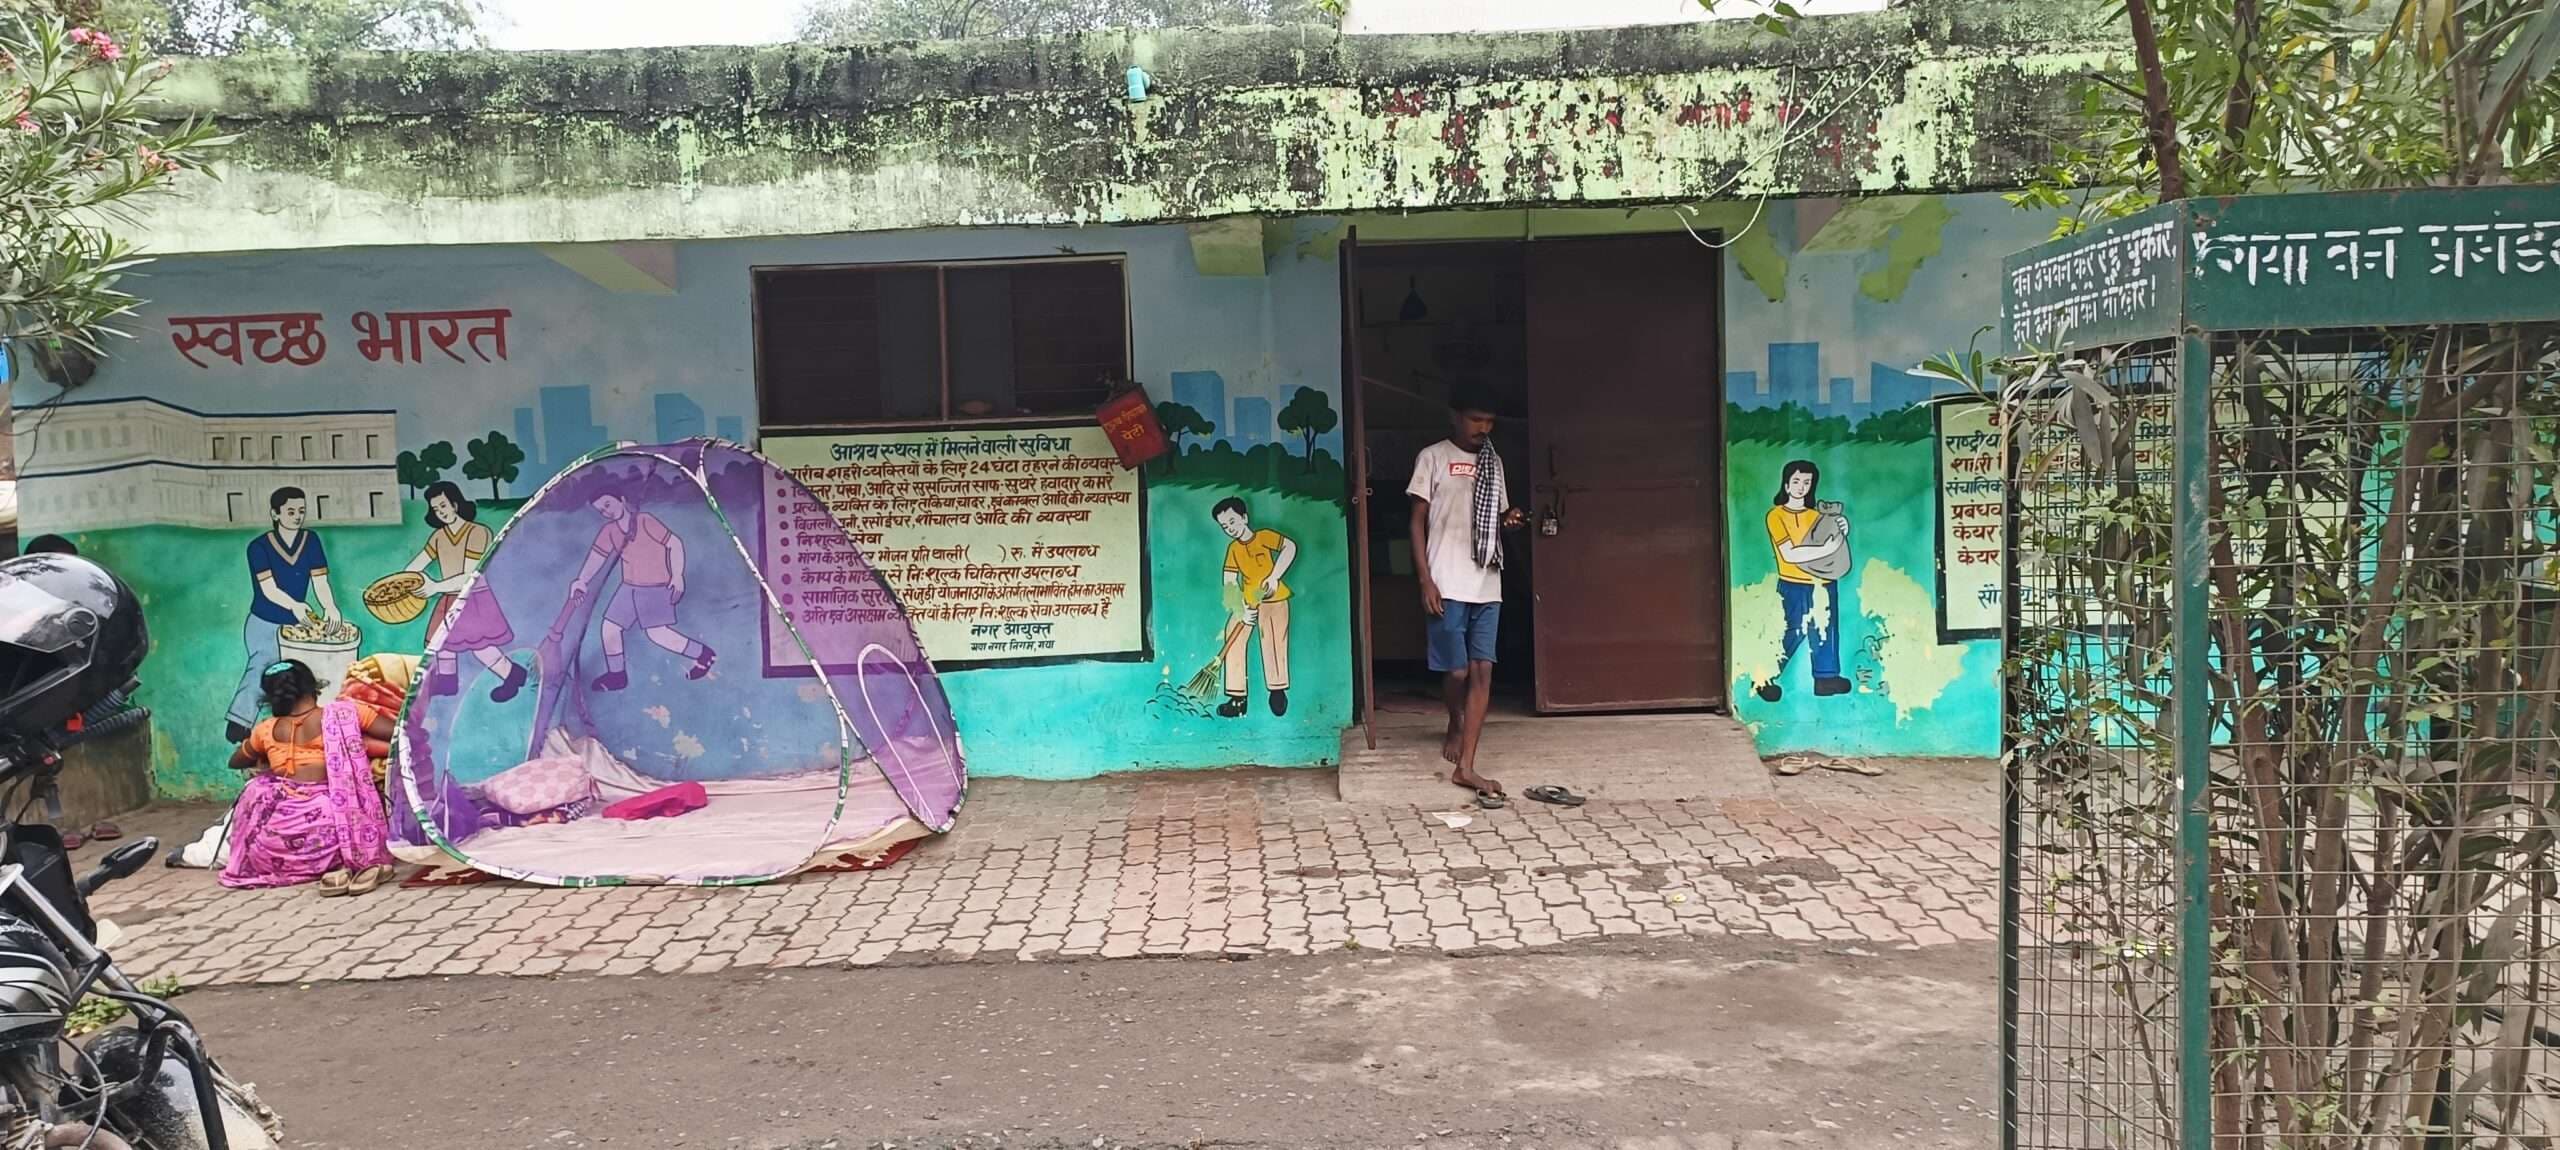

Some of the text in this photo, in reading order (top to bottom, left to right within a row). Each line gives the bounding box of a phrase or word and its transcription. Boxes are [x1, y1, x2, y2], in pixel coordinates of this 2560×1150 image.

[2324, 226, 2404, 280] वन
[2012, 265, 2032, 297] वन
[2073, 243, 2097, 280] कर
[168, 309, 512, 369] स्वच्छ भारत
[831, 433, 1072, 461] आश्रय स्थल में मिलने वाली सुविधा
[826, 462, 862, 481] शहरी
[862, 459, 922, 480] व्यक्तियों
[922, 459, 939, 476] के
[940, 460, 968, 478] लिए
[970, 460, 990, 475] 24
[990, 456, 1019, 474] घंटा
[1021, 454, 1061, 475] ठहरने
[1062, 453, 1081, 472] की
[1080, 456, 1123, 473] व्यवस्
[865, 479, 895, 498] आदि
[896, 479, 909, 494] से
[912, 477, 970, 498] सुसज्जित
[1040, 475, 1081, 492] हवादार
[1082, 470, 1114, 491] कमरे
[831, 497, 871, 513] व्यक्ति
[872, 496, 888, 512] के
[891, 497, 917, 514] लिए
[1042, 491, 1069, 508] आदि
[1084, 491, 1132, 506] व्यवस्था
[974, 508, 1008, 526] आदि
[1010, 508, 1033, 524] की
[1036, 510, 1092, 526] व्यवस्था
[1953, 523, 1998, 542] केयर
[878, 547, 908, 563] भोजन
[911, 544, 931, 565] प्रति
[1032, 542, 1045, 559] में
[1045, 545, 1101, 561] उपलब्ध
[1957, 546, 2000, 566] केयर
[833, 566, 849, 585] के
[887, 564, 903, 584] से
[965, 562, 1020, 582] चिकित्सा
[1021, 564, 1082, 581] उपलब्ध
[802, 586, 860, 608] सामाजिक
[902, 584, 915, 605] से
[951, 603, 978, 623] लिए
[1029, 600, 1052, 620] सेवा
[1052, 601, 1099, 618] उपलब्ध
[1100, 596, 1112, 619] है
[971, 621, 1055, 640] नगर आयुक्त
[1037, 640, 1056, 650] गया
